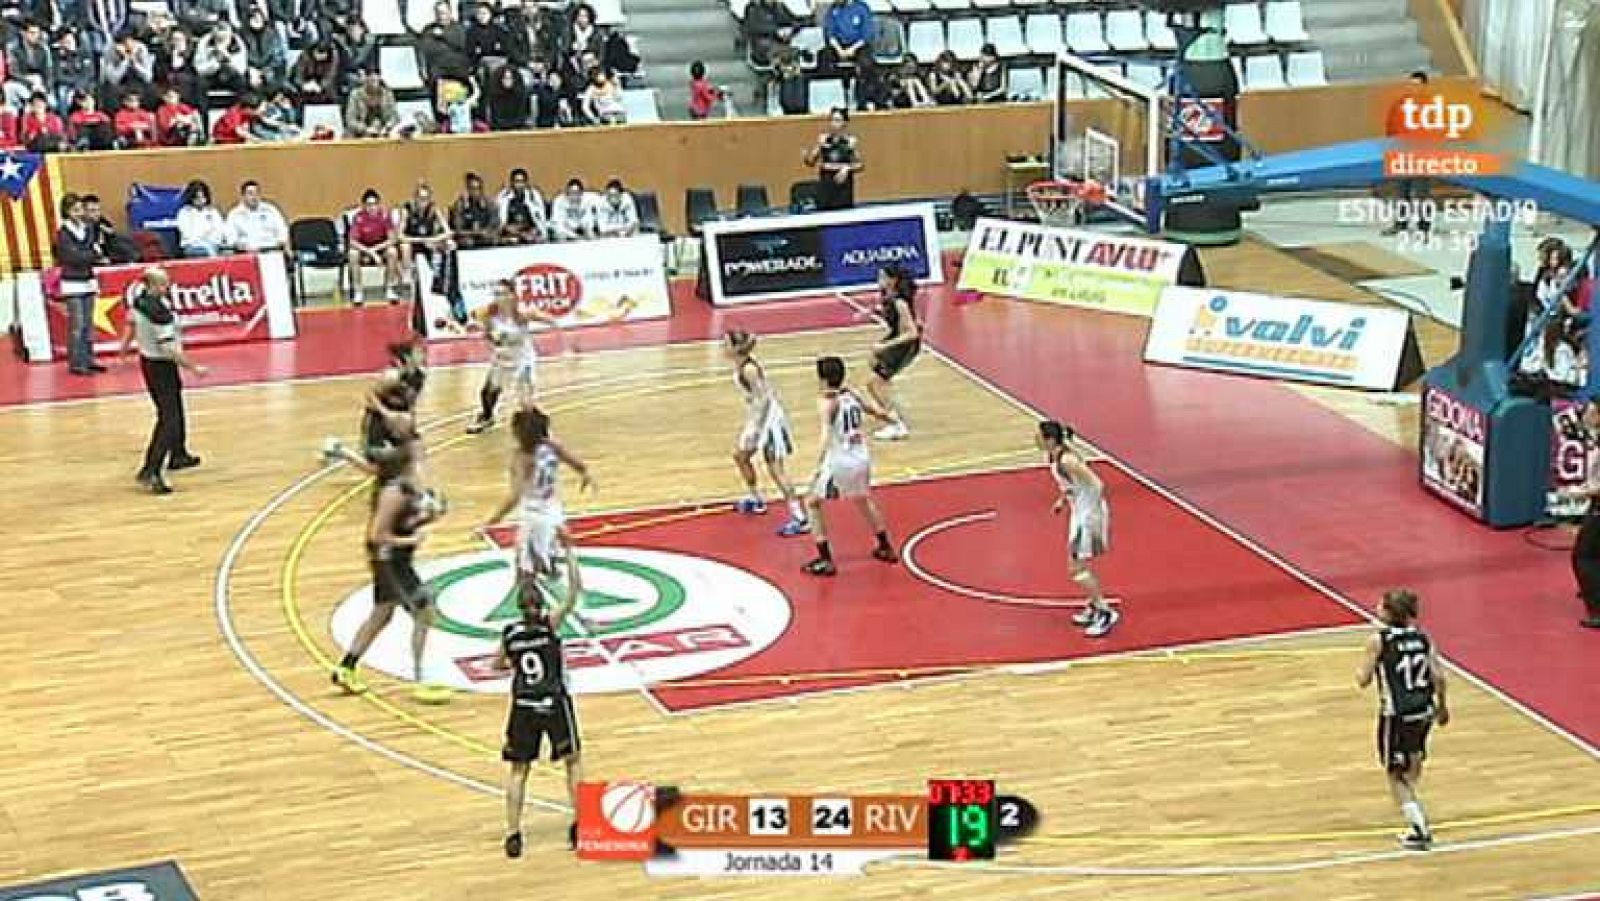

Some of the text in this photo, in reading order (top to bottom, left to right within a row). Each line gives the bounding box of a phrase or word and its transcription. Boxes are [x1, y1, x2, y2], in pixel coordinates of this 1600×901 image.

[126, 274, 254, 311] Etrella
[516, 272, 568, 298] FRIT
[1225, 314, 1366, 351] valvi
[520, 650, 545, 685] 9
[1395, 653, 1429, 691] 12
